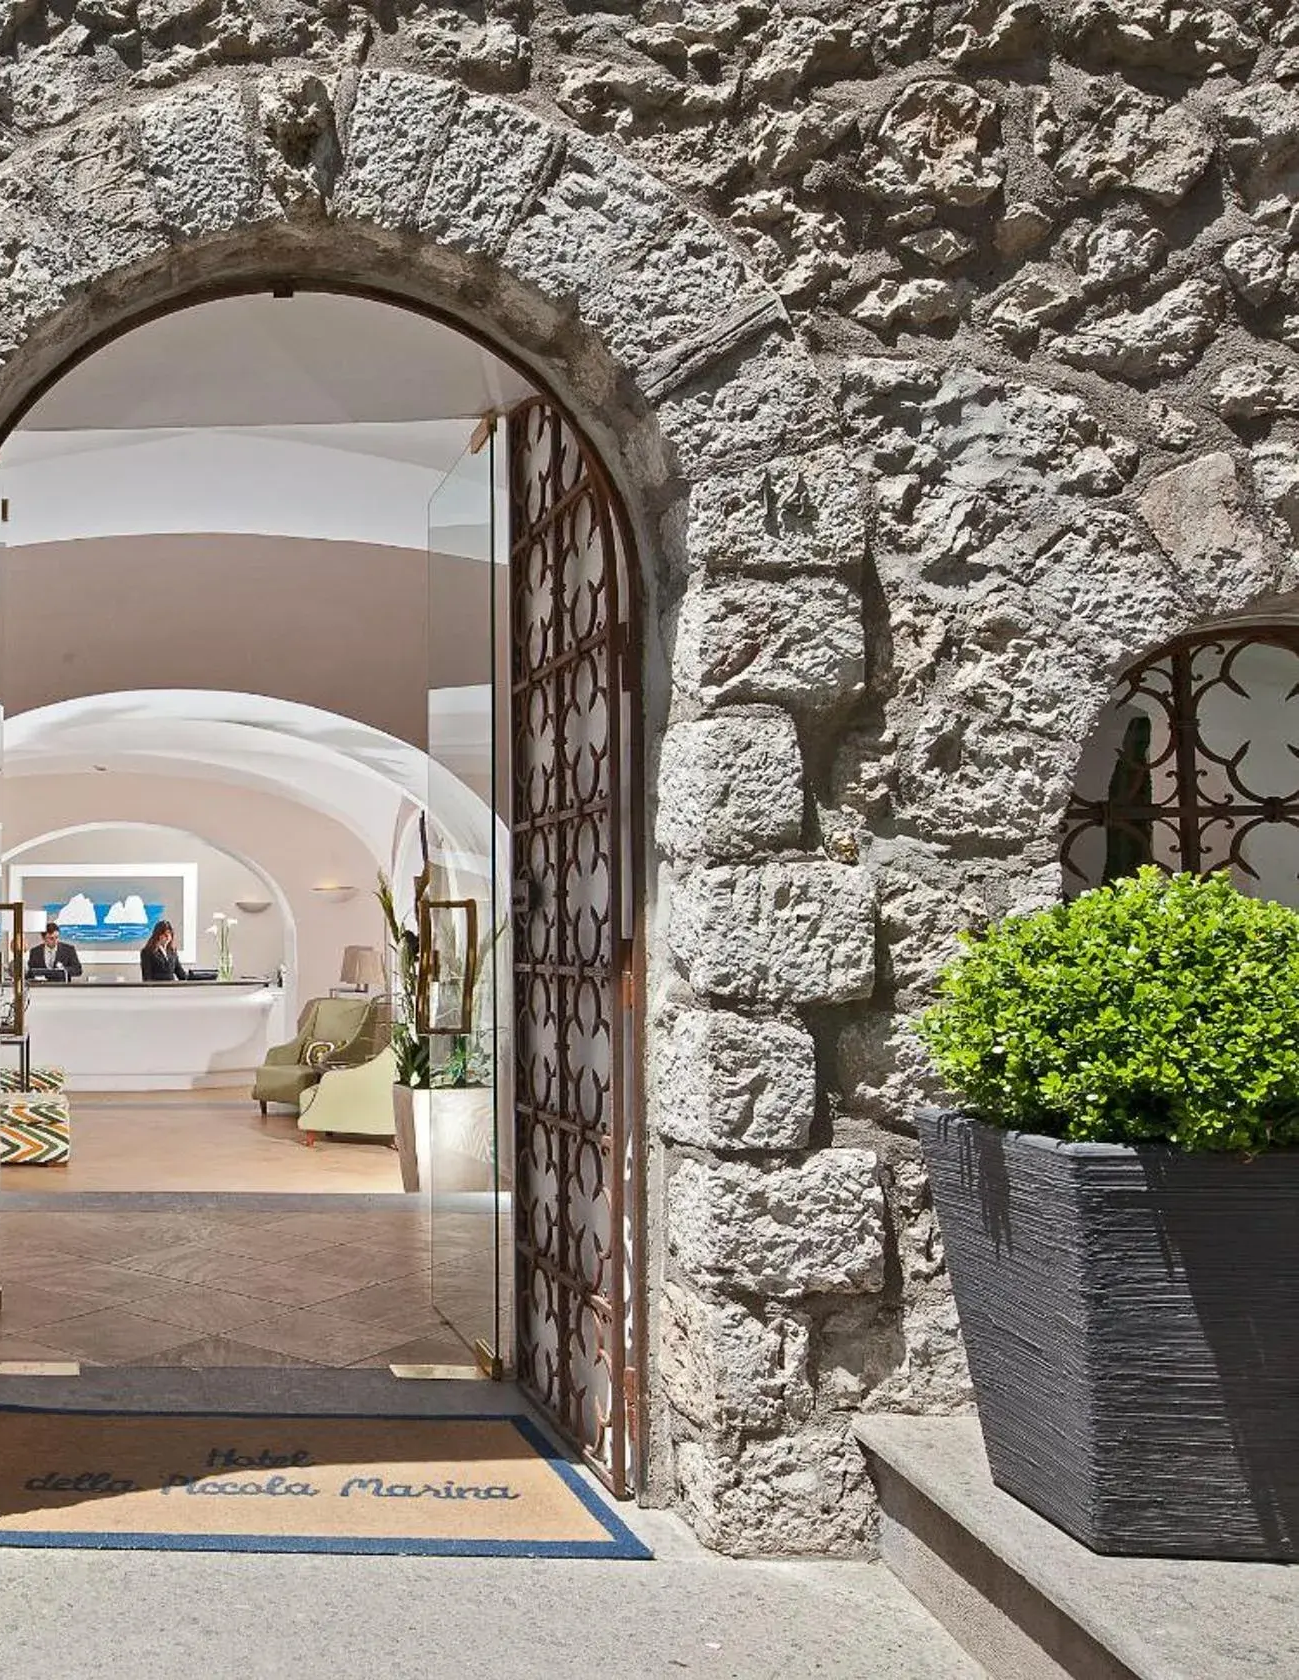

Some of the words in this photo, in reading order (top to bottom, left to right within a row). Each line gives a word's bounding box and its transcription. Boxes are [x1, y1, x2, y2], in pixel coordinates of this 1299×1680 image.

[206, 1447, 315, 1468] Hotel
[24, 1471, 141, 1493] della
[158, 1473, 321, 1496] Piccola
[340, 1476, 521, 1499] Marina
